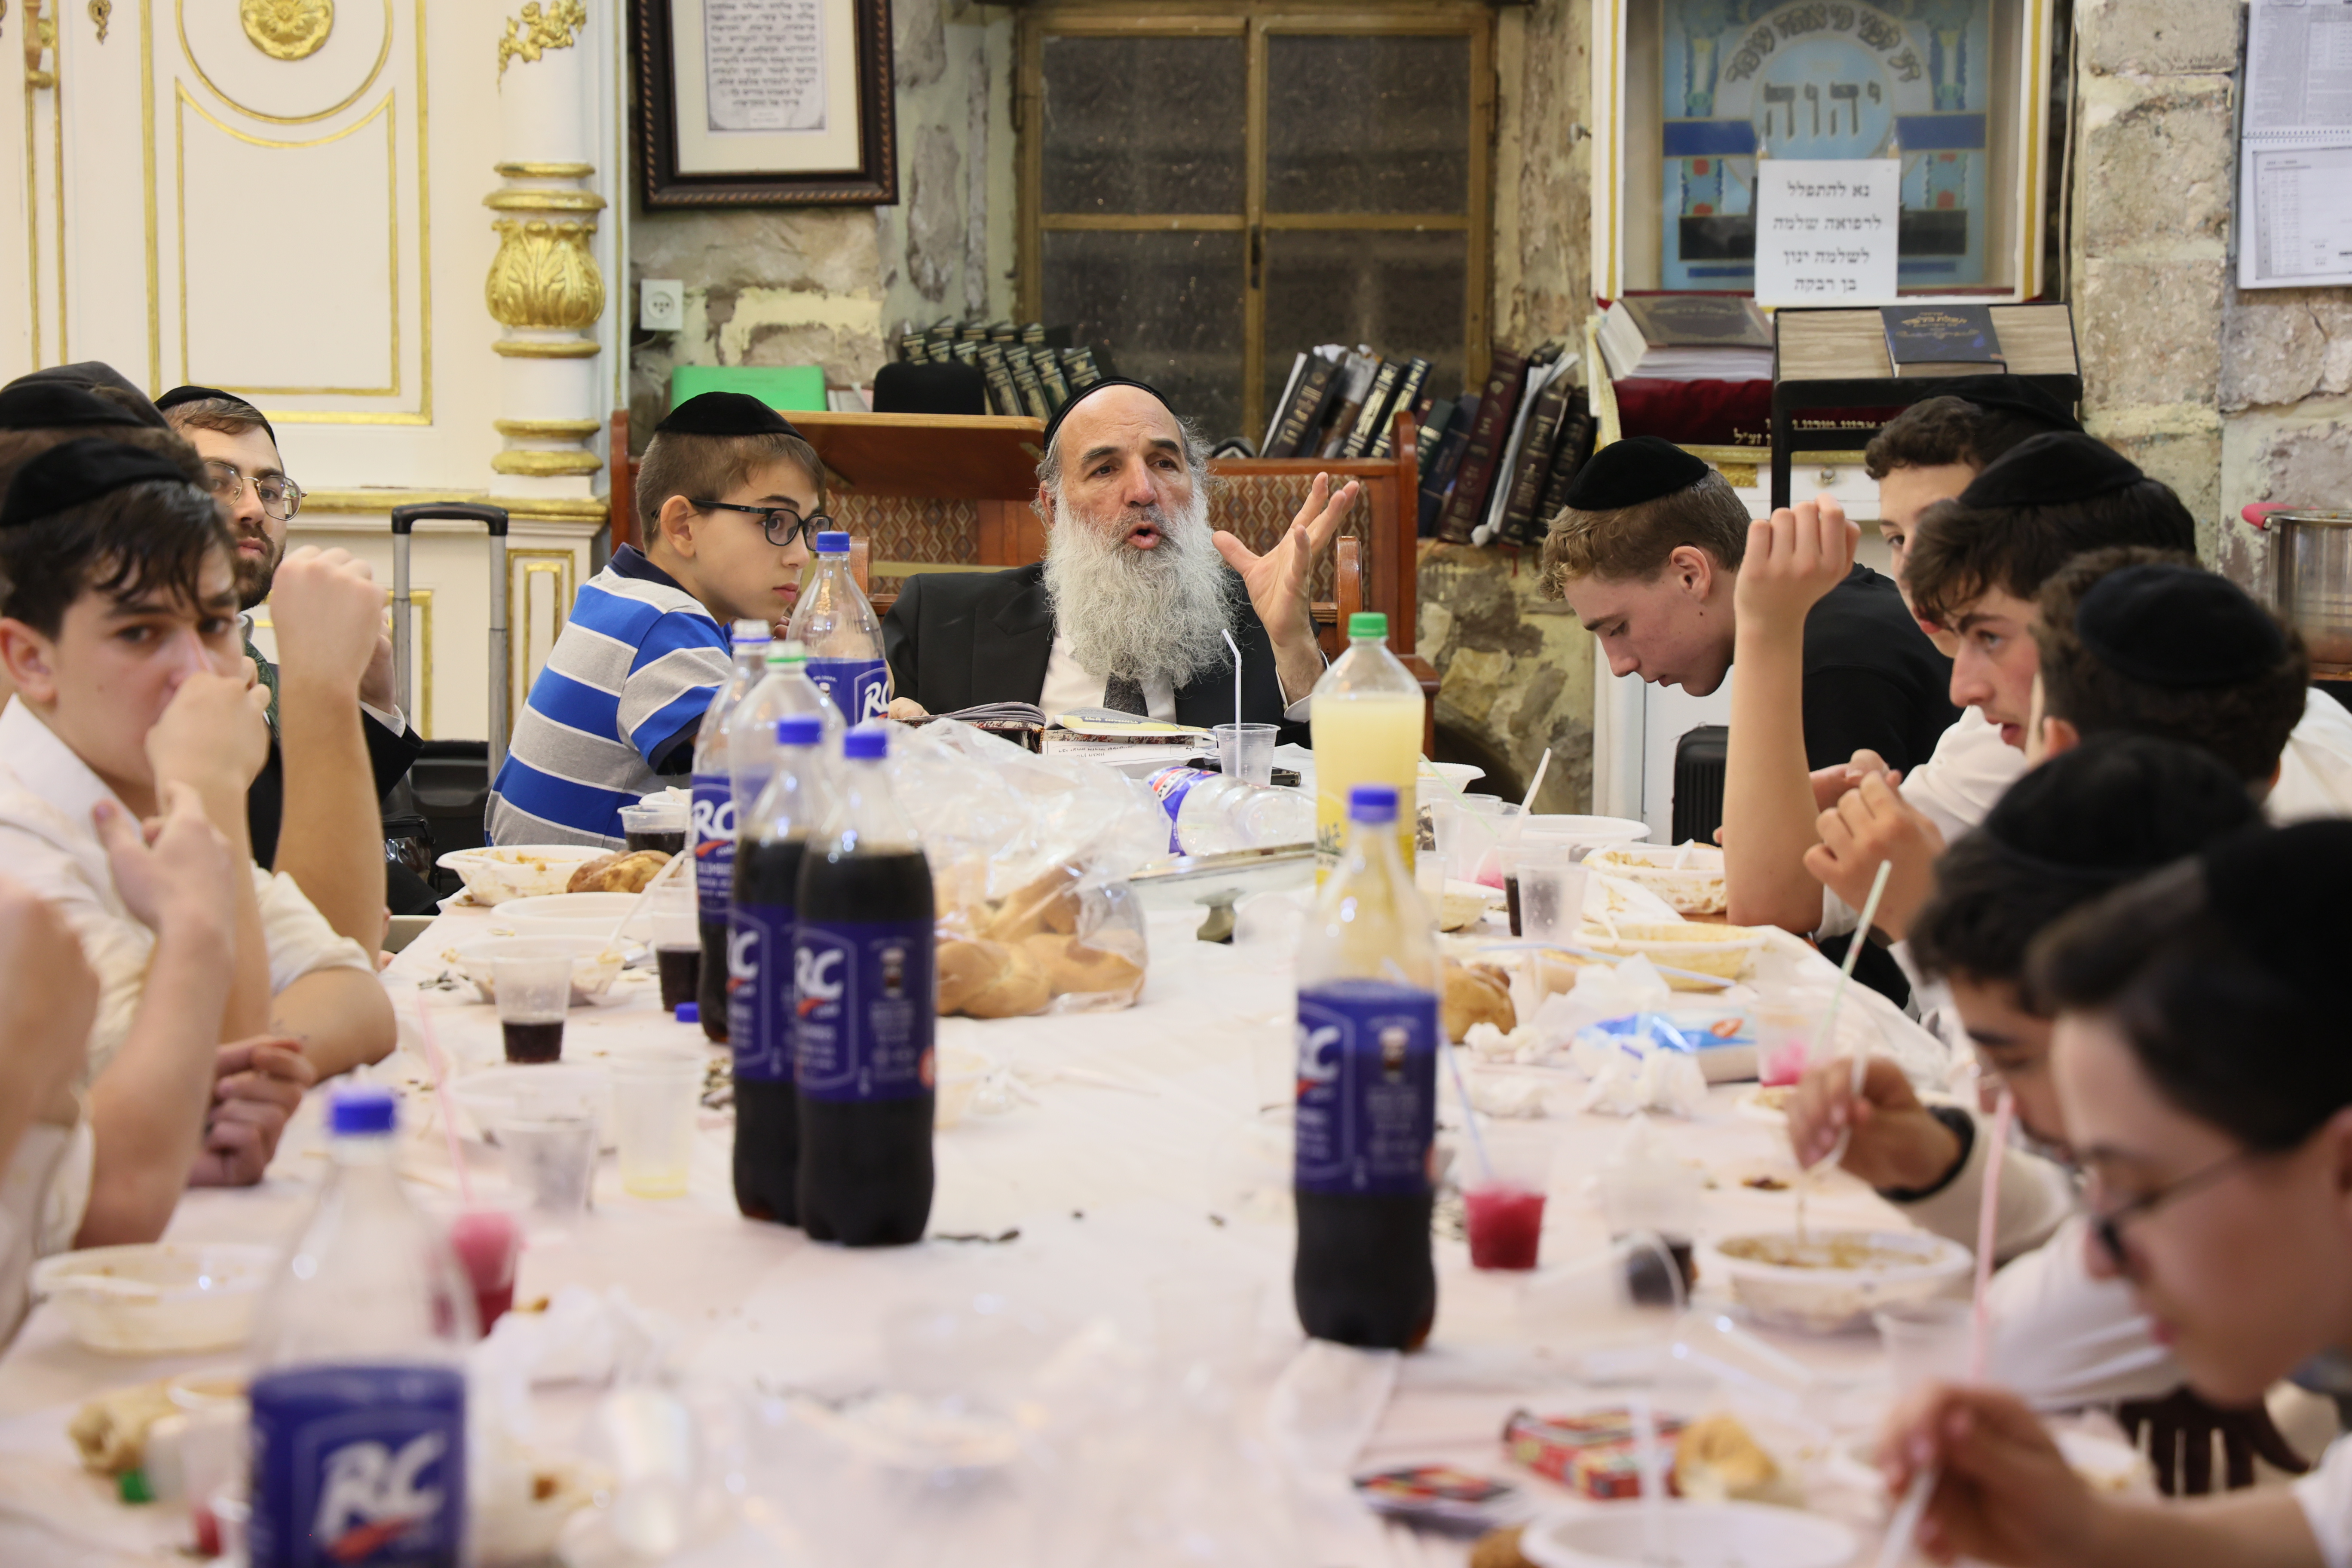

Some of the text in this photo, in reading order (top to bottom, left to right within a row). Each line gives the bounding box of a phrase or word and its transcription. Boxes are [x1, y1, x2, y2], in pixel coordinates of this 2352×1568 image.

[1764, 80, 1881, 138] יהוה
[1787, 180, 1869, 197] נא להתפלל
[1773, 213, 1882, 230] לרפואה שלמה
[1815, 246, 1870, 263] לשלמה
[1794, 279, 1856, 293] בן רבקה
[692, 799, 736, 845] RC
[313, 1430, 448, 1547] RC
